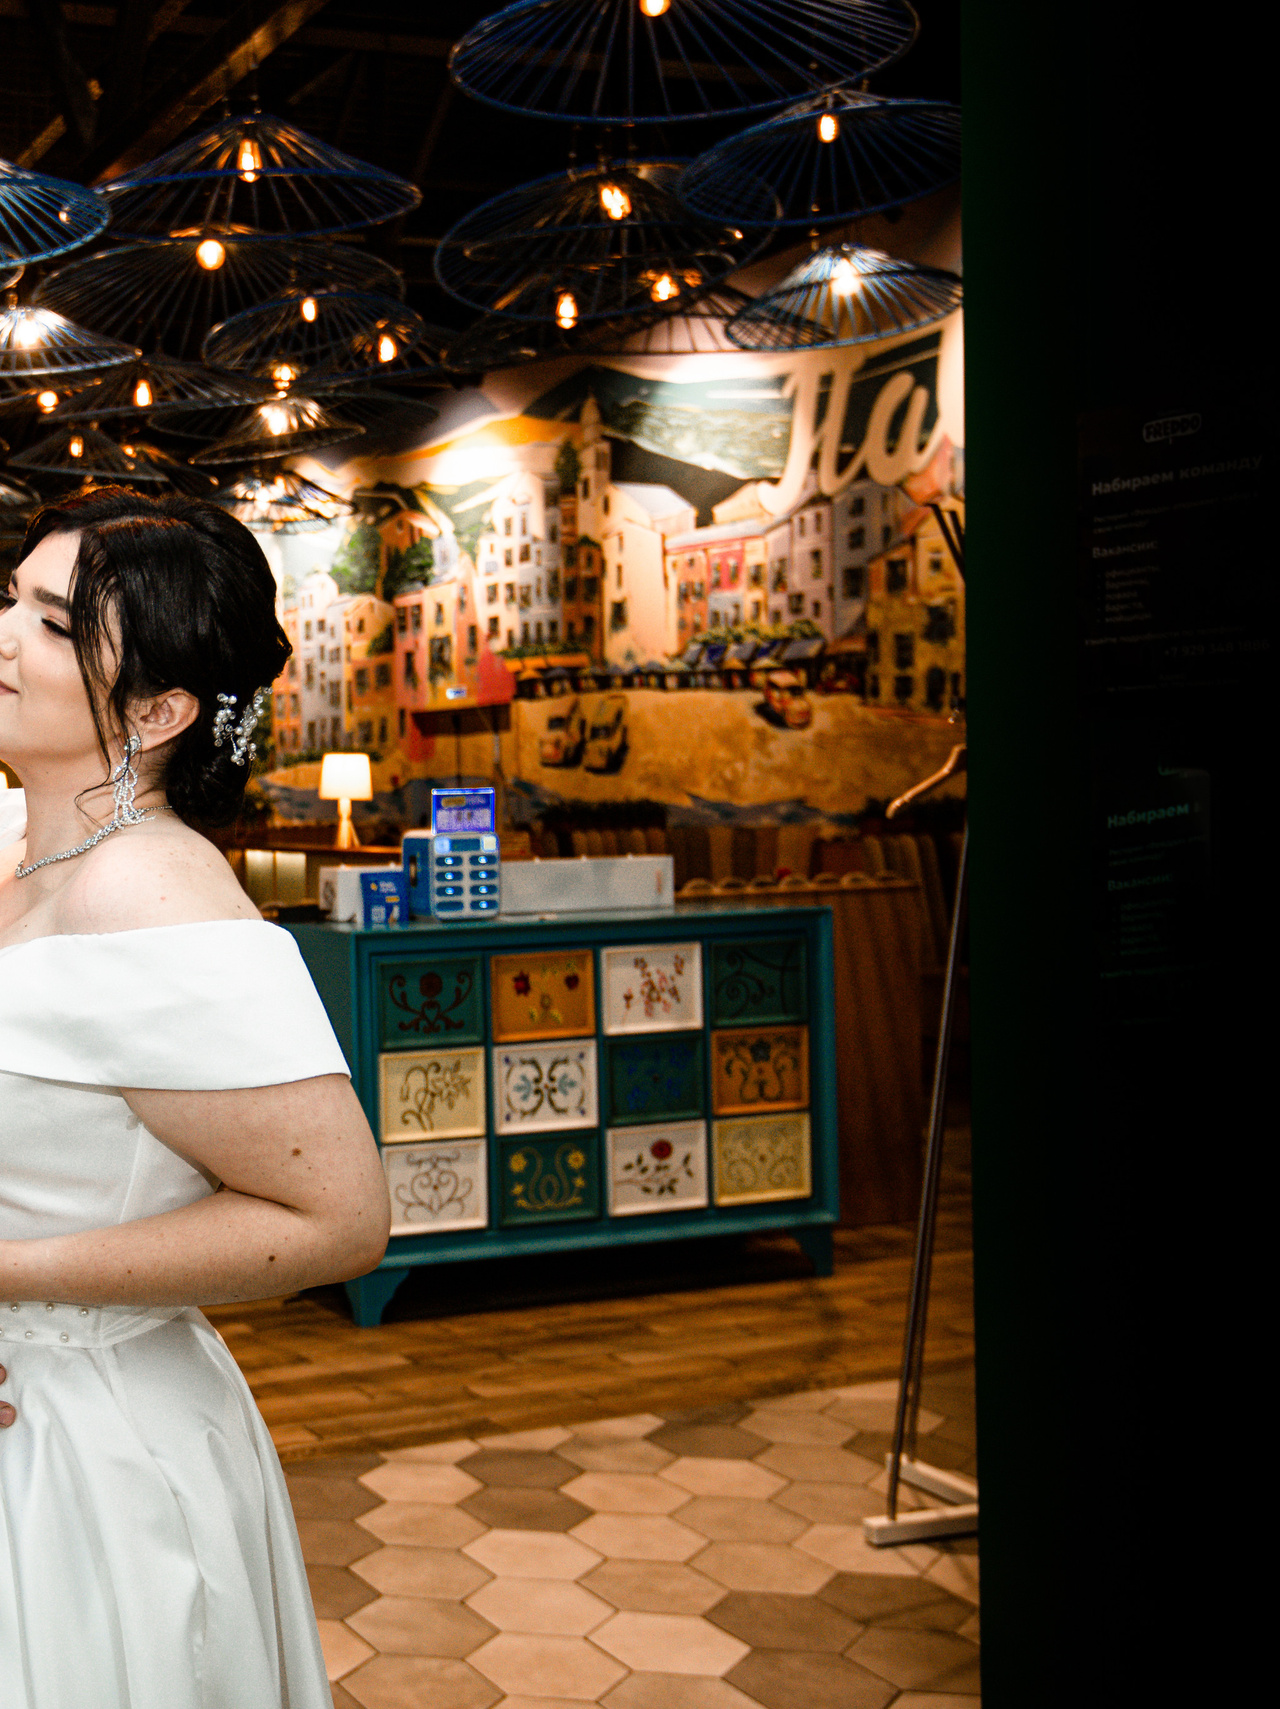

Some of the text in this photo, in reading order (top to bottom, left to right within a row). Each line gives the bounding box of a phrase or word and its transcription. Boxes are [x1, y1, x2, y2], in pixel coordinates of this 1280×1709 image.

[1145, 415, 1200, 440] FREDDO
[1091, 453, 1263, 496] Набираем команду
[1106, 803, 1190, 829] Набираем
